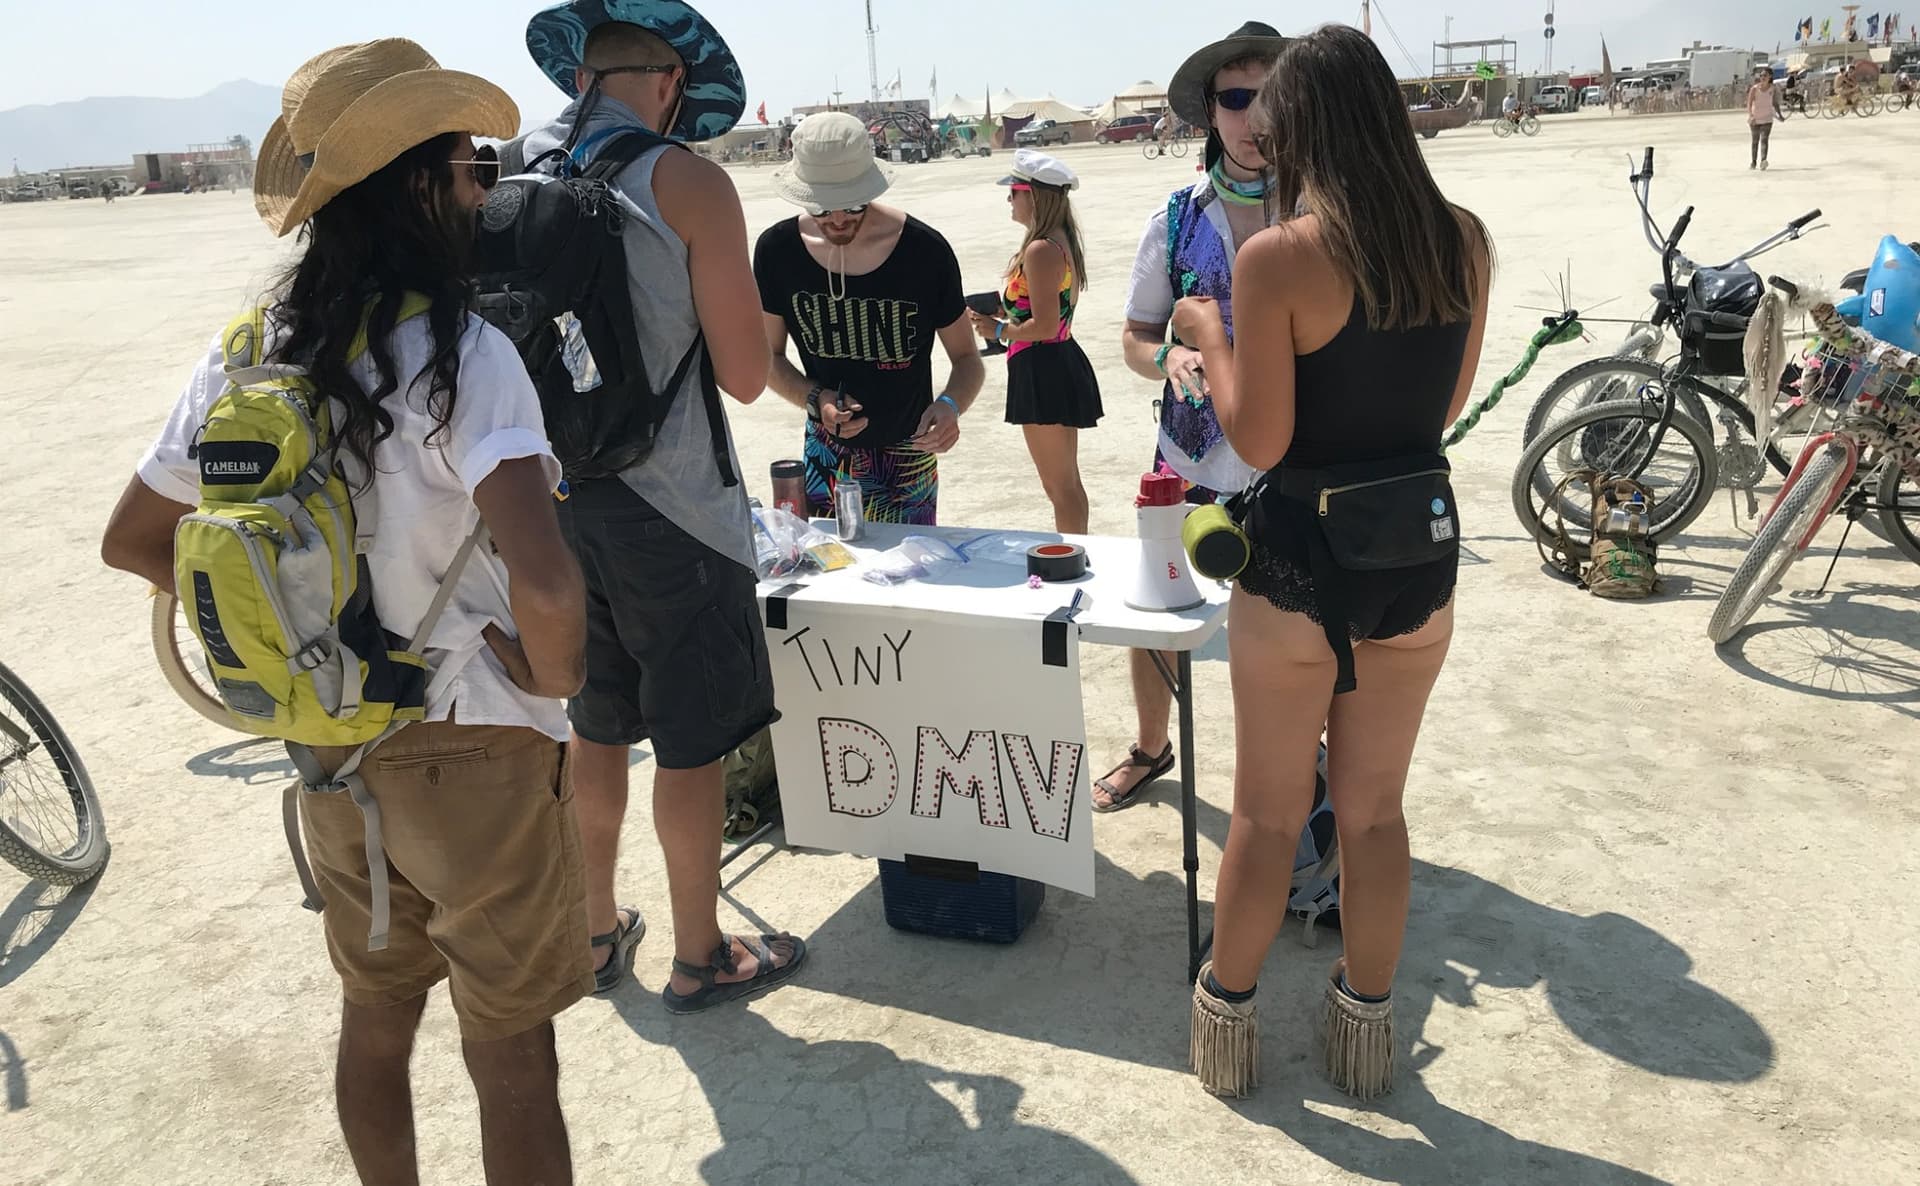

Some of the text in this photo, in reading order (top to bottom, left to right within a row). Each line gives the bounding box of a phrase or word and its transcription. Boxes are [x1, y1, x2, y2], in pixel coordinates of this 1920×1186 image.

[792, 291, 918, 362] SHINE
[205, 461, 260, 474] CAMELBAK
[783, 627, 912, 691] TINY
[818, 718, 1083, 841] DMV
